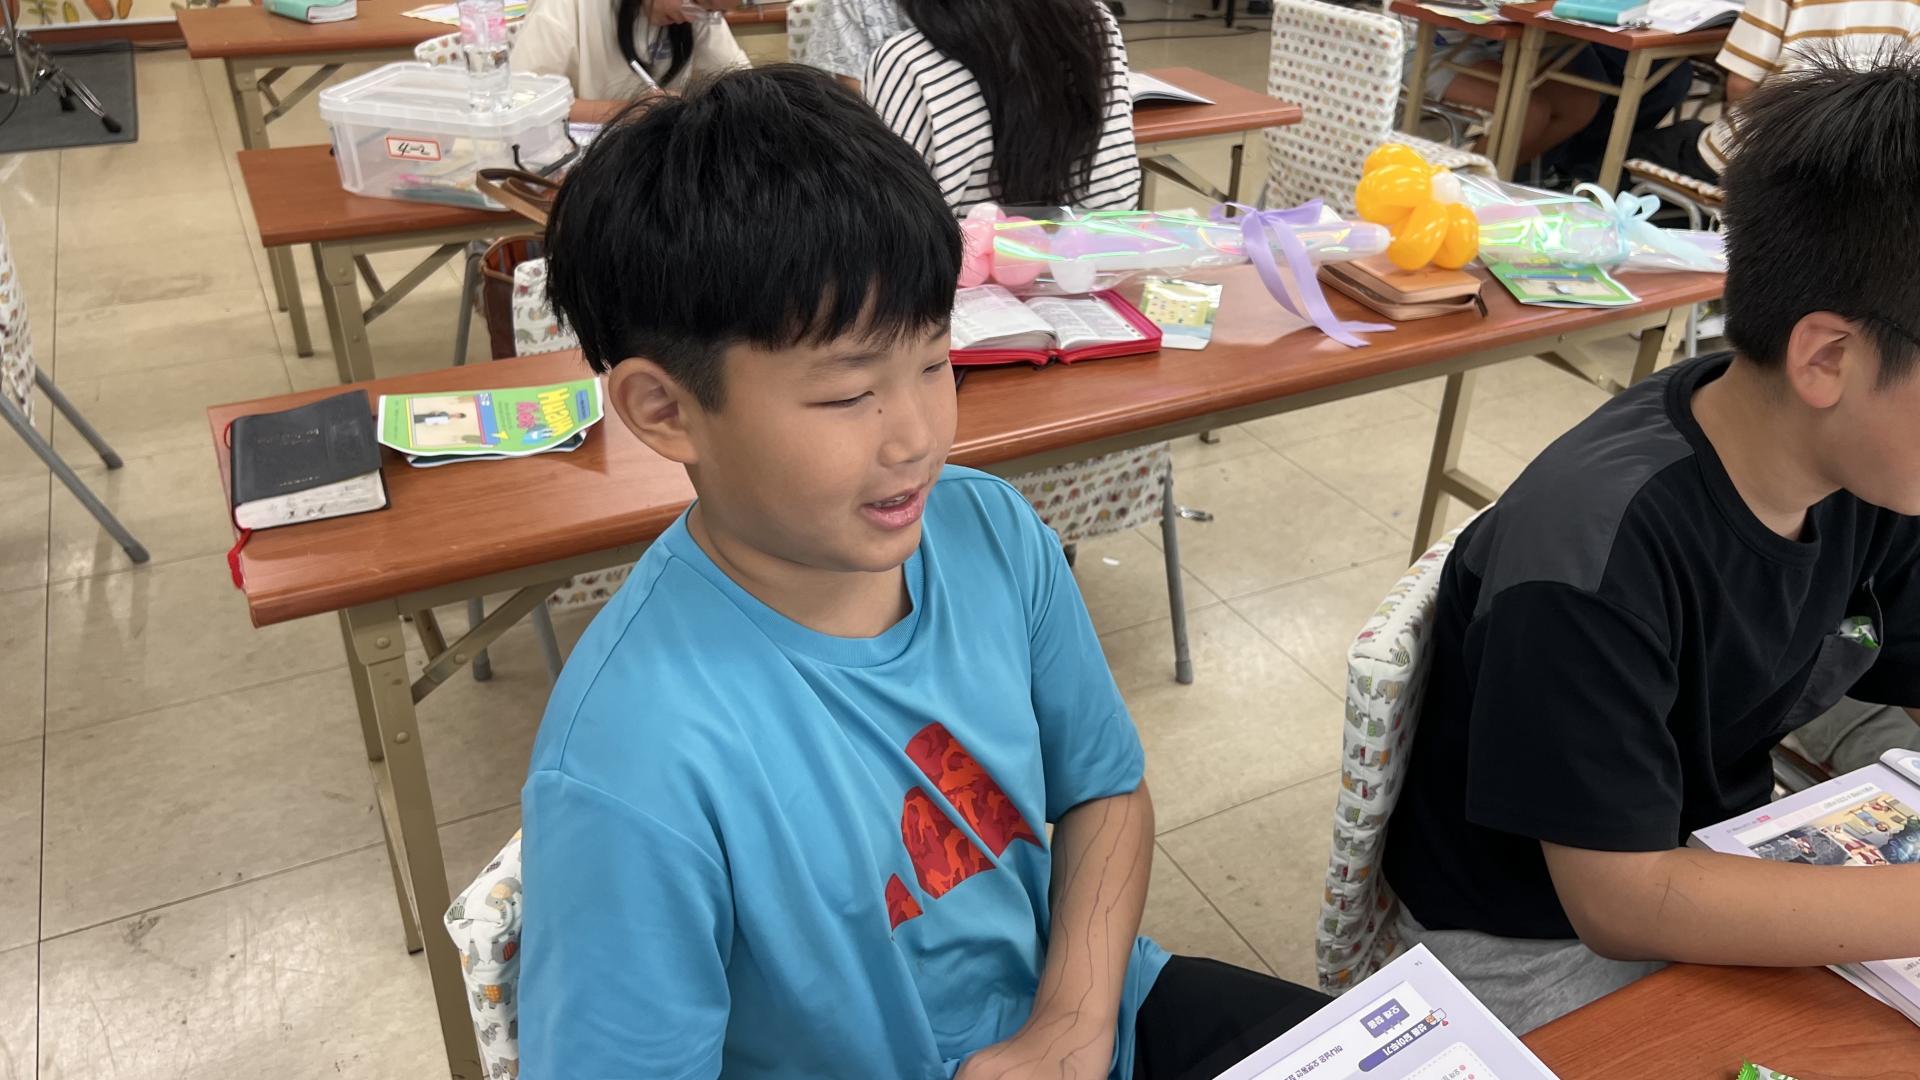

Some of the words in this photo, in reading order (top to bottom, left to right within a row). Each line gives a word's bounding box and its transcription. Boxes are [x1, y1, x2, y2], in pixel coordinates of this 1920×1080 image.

[1382, 1004, 1400, 1019] 오래
[1410, 1023, 1427, 1037] 성품
[1318, 1044, 1343, 1063] 하나님은
[1295, 1059, 1320, 1078] 오랫동안
